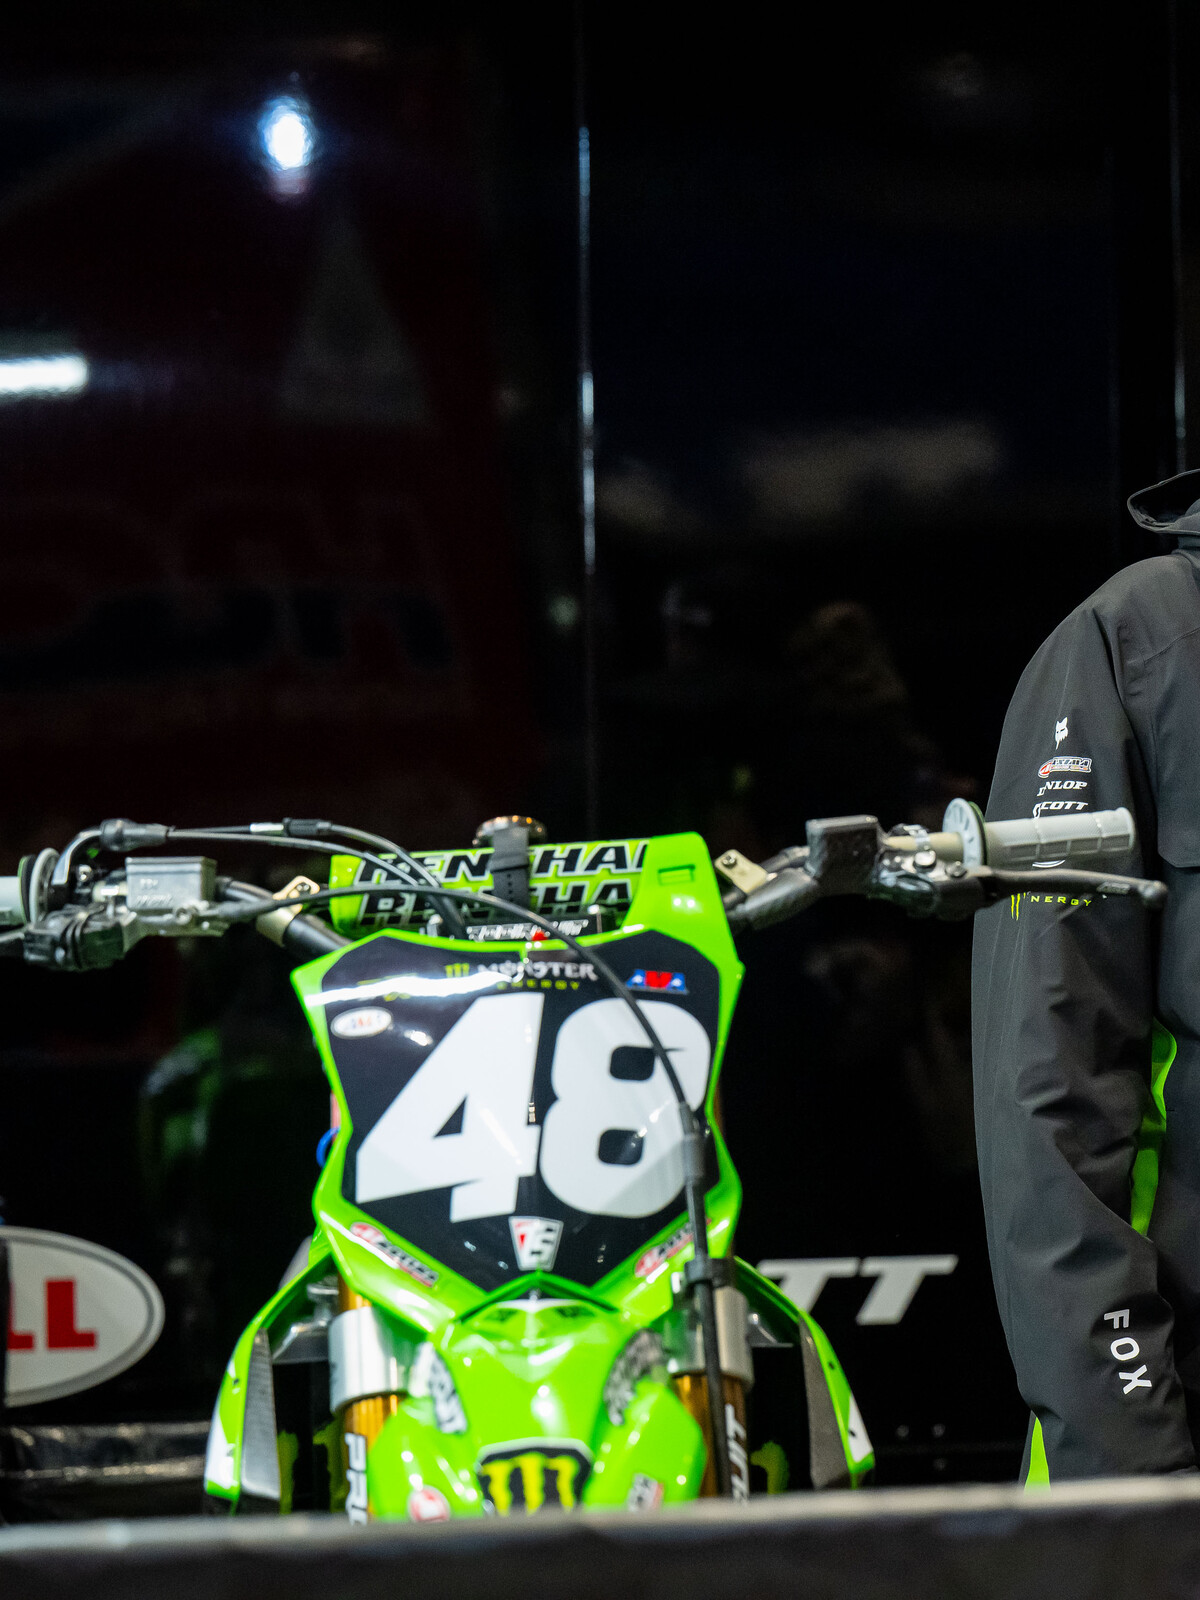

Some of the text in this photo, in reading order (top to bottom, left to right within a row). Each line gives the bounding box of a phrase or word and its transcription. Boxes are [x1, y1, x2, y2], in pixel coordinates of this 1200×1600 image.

[1030, 895, 1092, 907] NERGY
[356, 993, 711, 1222] 48
[1104, 1309, 1152, 1395] FOX
